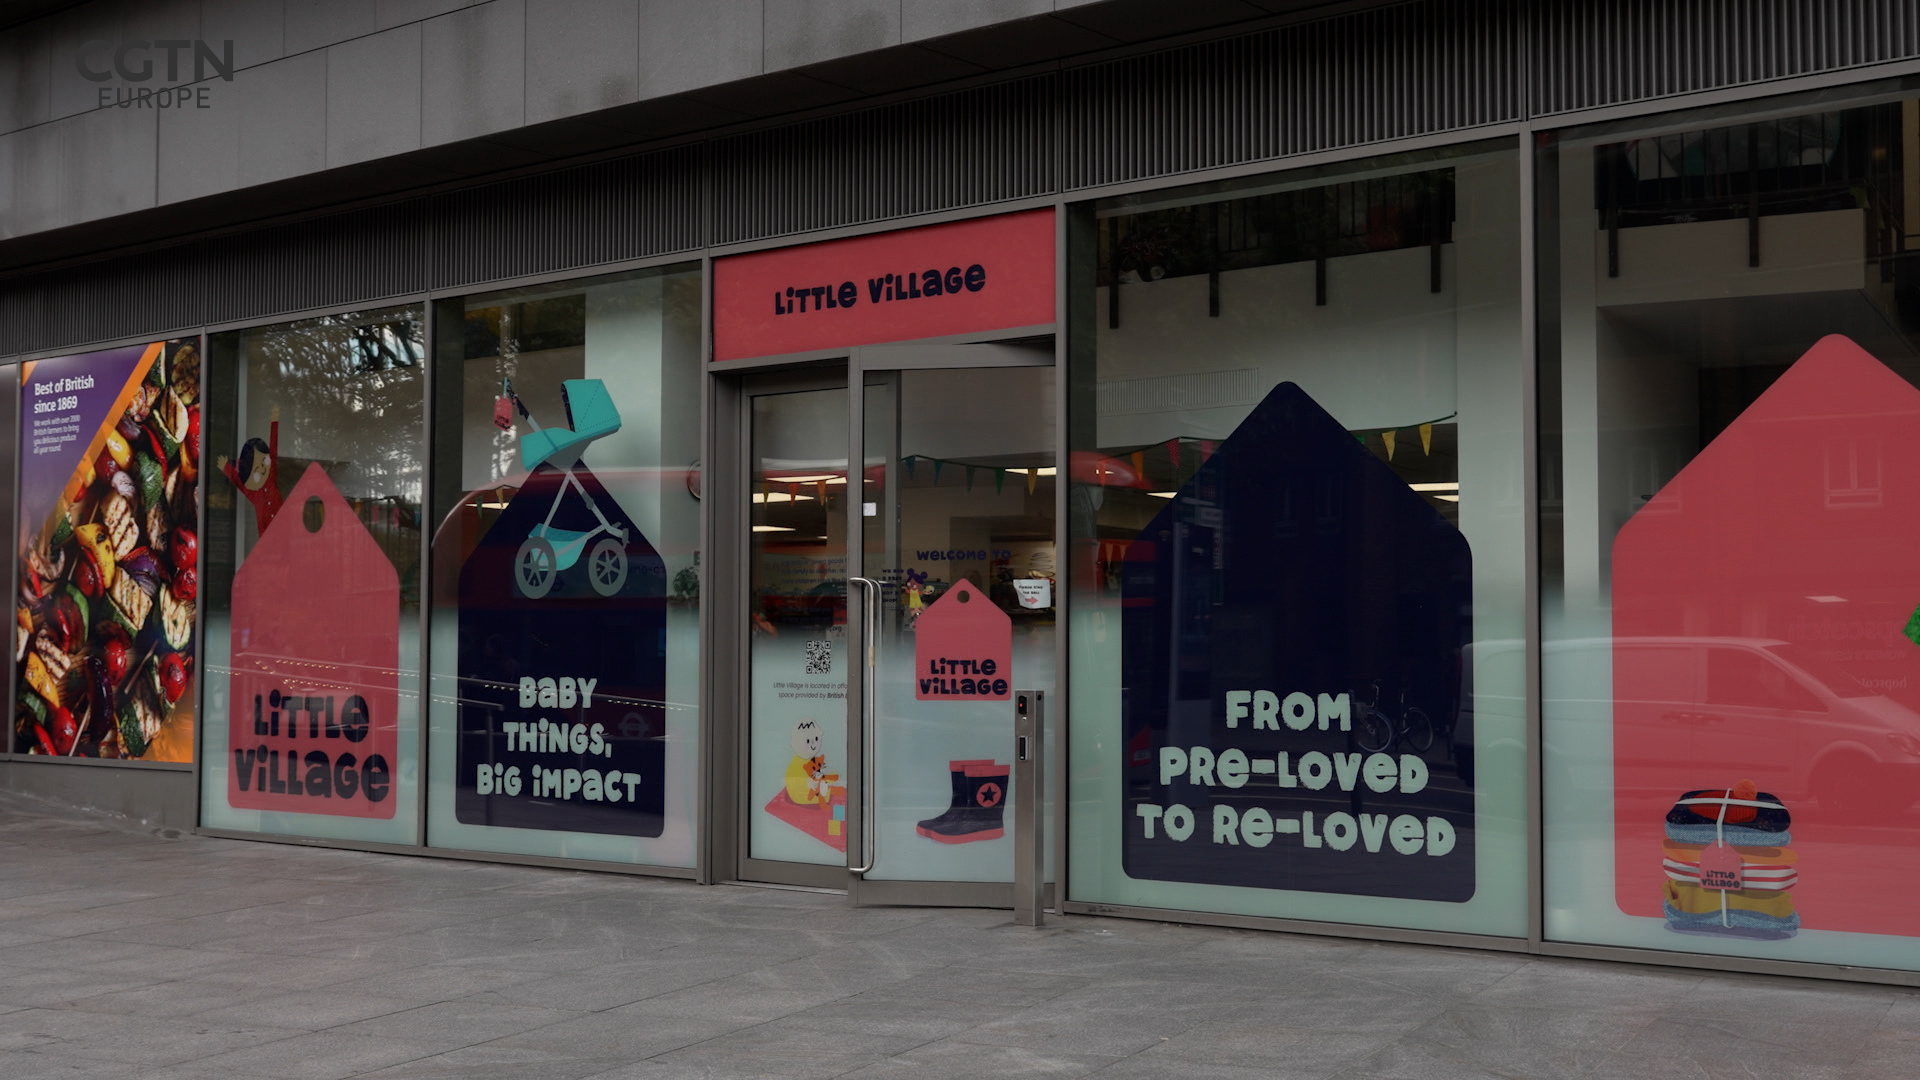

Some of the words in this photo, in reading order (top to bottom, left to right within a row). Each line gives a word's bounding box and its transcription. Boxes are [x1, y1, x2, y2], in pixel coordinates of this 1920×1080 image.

[34, 380, 54, 396] Best
[54, 378, 65, 393] of
[65, 374, 95, 392] British
[34, 399, 56, 414] since
[57, 395, 78, 411] 1869
[41, 418, 51, 426] work
[51, 417, 61, 425] with
[61, 416, 70, 424] over
[33, 427, 47, 436] British
[47, 426, 63, 435] farmers
[68, 424, 80, 433] bring
[42, 436, 60, 445] delicious
[60, 434, 77, 443] produce
[786, 682, 804, 690] Village
[795, 691, 818, 699] provided
[1225, 689, 1351, 731] FROM
[1136, 803, 1196, 842] TO
